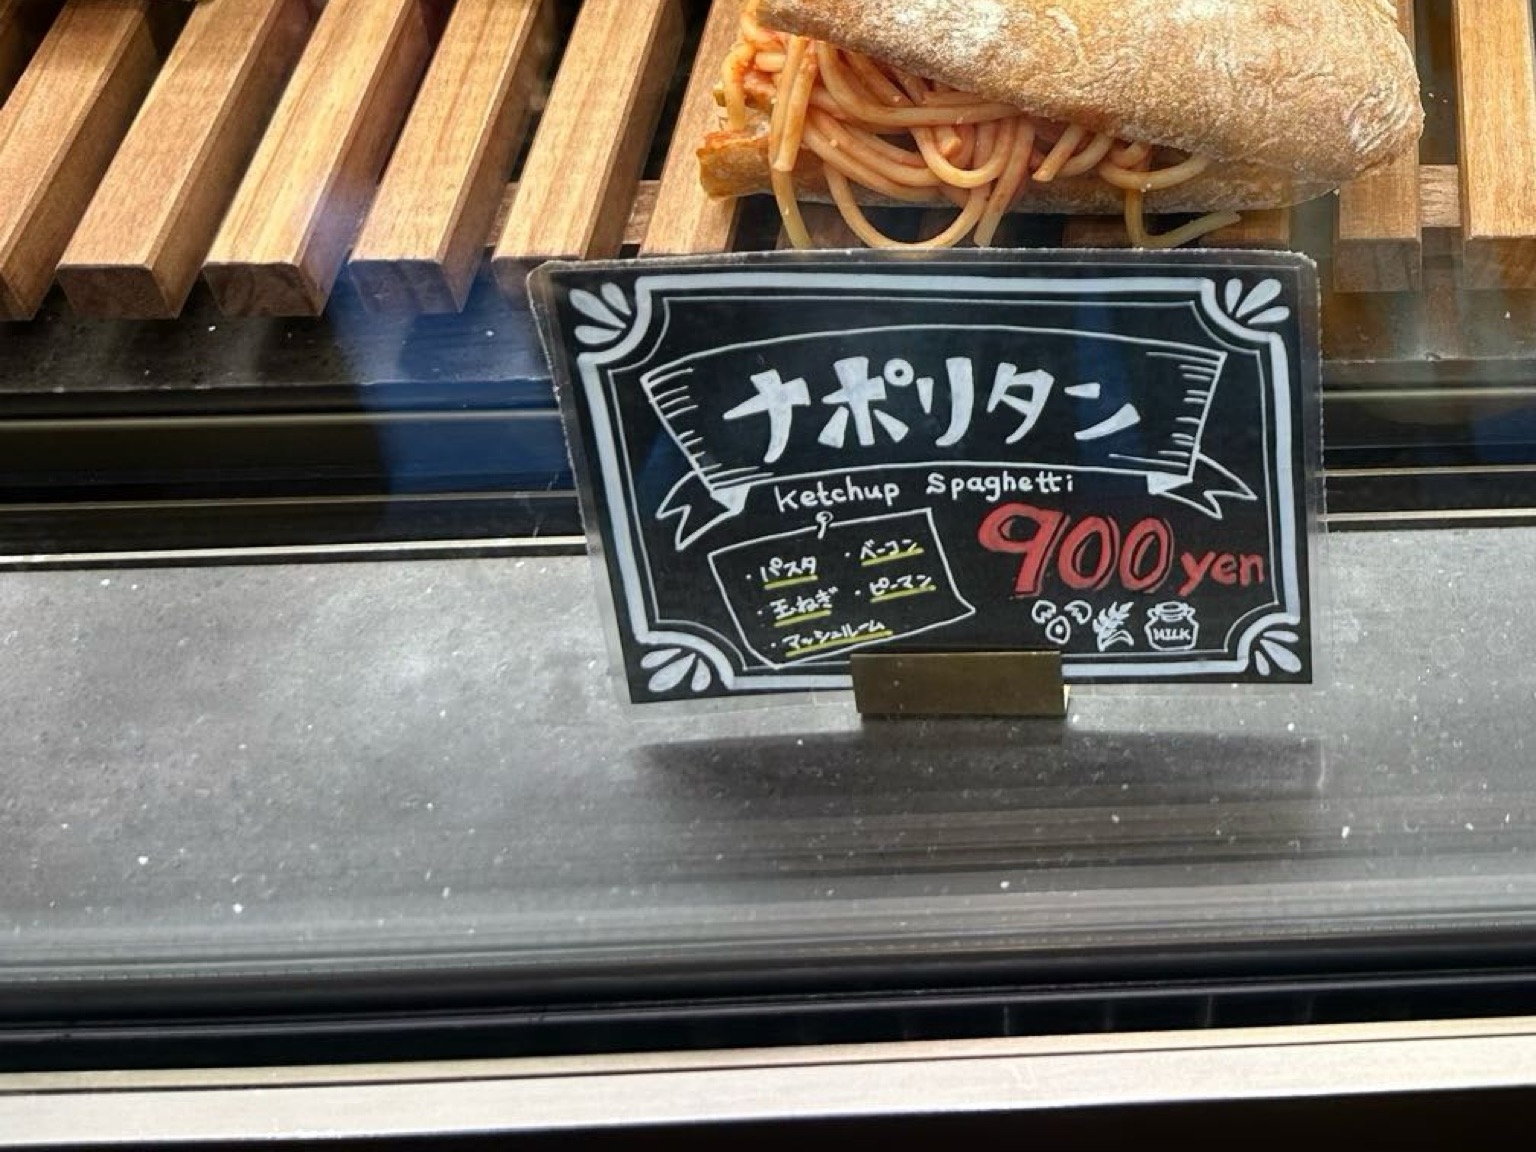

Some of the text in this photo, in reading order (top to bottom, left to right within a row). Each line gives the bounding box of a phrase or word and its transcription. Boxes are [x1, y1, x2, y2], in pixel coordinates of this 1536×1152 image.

[722, 356, 1141, 464] ナポリタン
[926, 470, 1075, 501] Spaghetti
[760, 539, 918, 583] パスタ ベーコン
[769, 574, 933, 620] 玉ねぎ ピーマン
[782, 619, 886, 651] マッシュルーム
[1152, 627, 1191, 641] MILK
